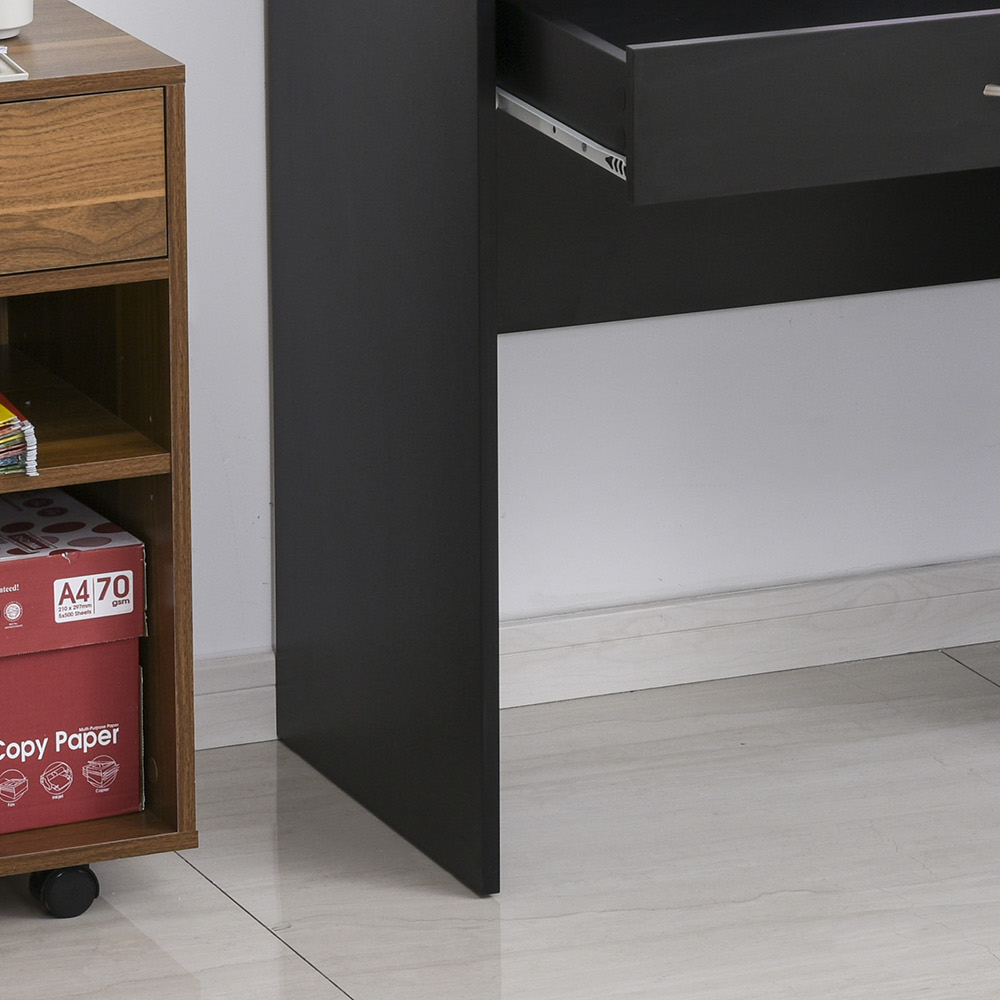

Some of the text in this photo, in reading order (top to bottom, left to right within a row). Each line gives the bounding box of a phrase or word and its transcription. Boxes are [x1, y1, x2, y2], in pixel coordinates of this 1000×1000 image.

[58, 574, 130, 606] A4 70
[111, 598, 131, 608] gsm
[55, 727, 120, 753] Paper
